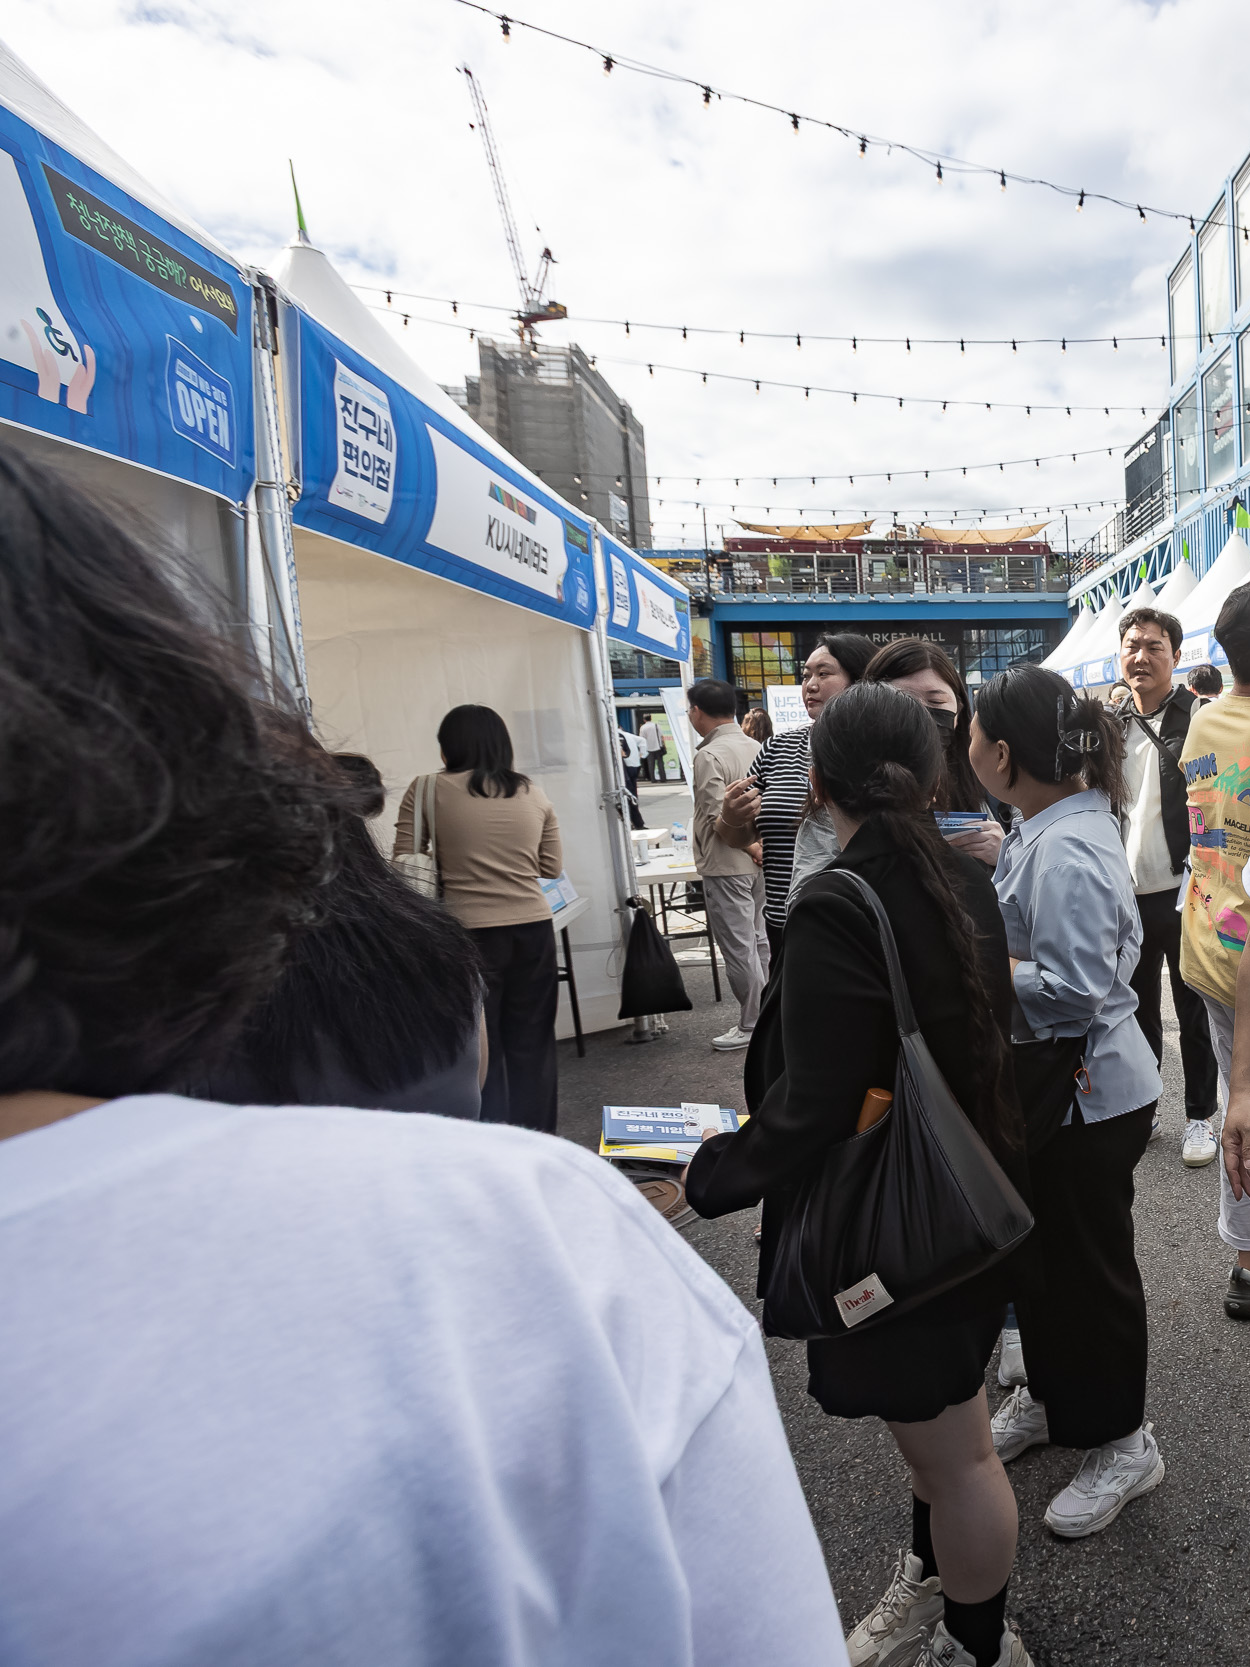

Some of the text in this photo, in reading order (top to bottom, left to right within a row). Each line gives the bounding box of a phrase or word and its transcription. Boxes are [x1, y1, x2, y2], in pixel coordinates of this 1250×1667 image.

[67, 192, 140, 262] 청년정책
[139, 239, 187, 289] 궁금해?
[176, 380, 230, 452] OPEN
[340, 394, 392, 452] 진구네
[342, 439, 391, 493] 편의점
[865, 633, 945, 643] ARKET HALL
[1184, 753, 1218, 786] MPING
[617, 1110, 684, 1121] 진구네 편의
